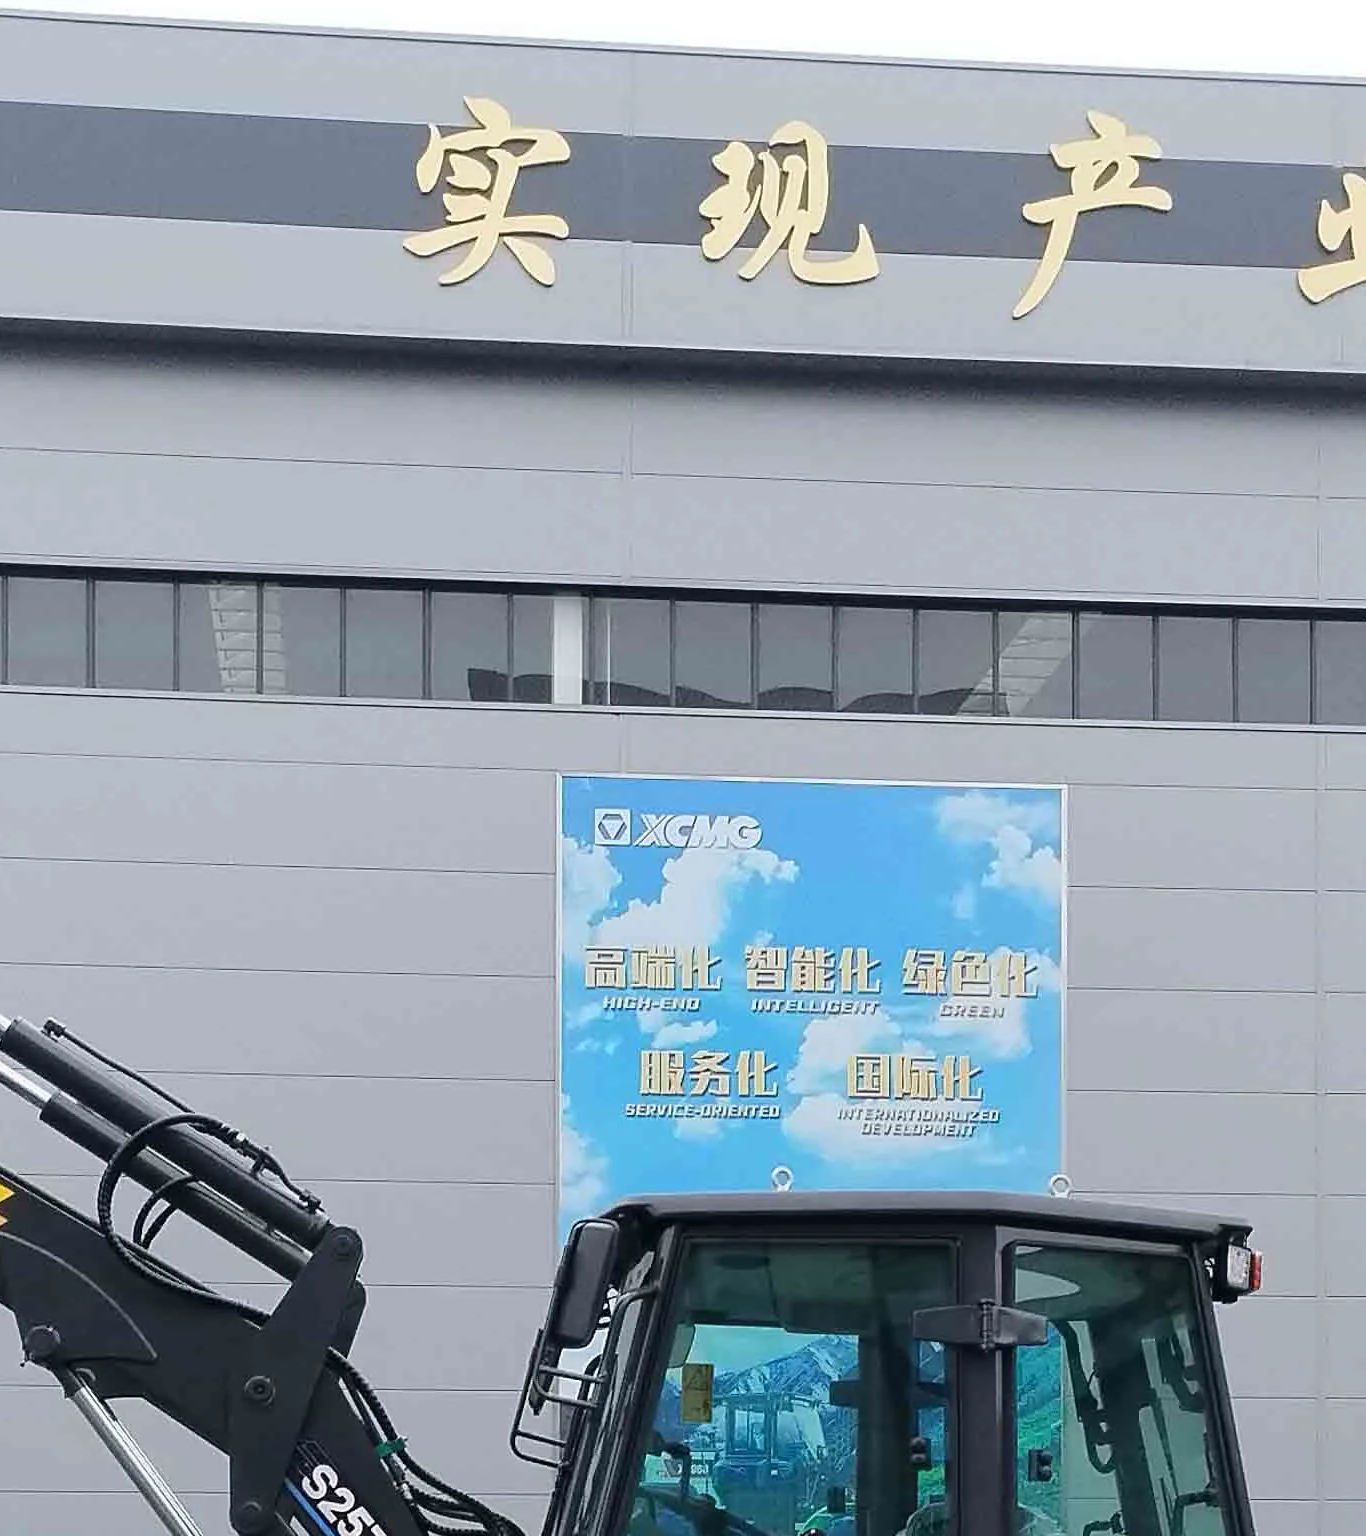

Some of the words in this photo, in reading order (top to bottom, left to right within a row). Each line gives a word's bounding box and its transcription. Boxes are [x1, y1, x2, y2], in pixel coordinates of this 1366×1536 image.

[633, 813, 763, 849] XCMG
[585, 943, 723, 992] 高端化
[745, 944, 882, 995] 智能化
[901, 947, 1040, 1000] 绿色化
[602, 996, 701, 1013] HIGH-END
[750, 998, 881, 1015] INTELLIGENT
[939, 1003, 1006, 1019] GREEN
[639, 1049, 779, 1098] 服务化
[846, 1053, 985, 1101] 国际化
[625, 1103, 781, 1119] SERVICE-ORIENTED
[837, 1108, 1002, 1124] INTERNATIONALIZED
[861, 1122, 978, 1138] DEVELOPMENT
